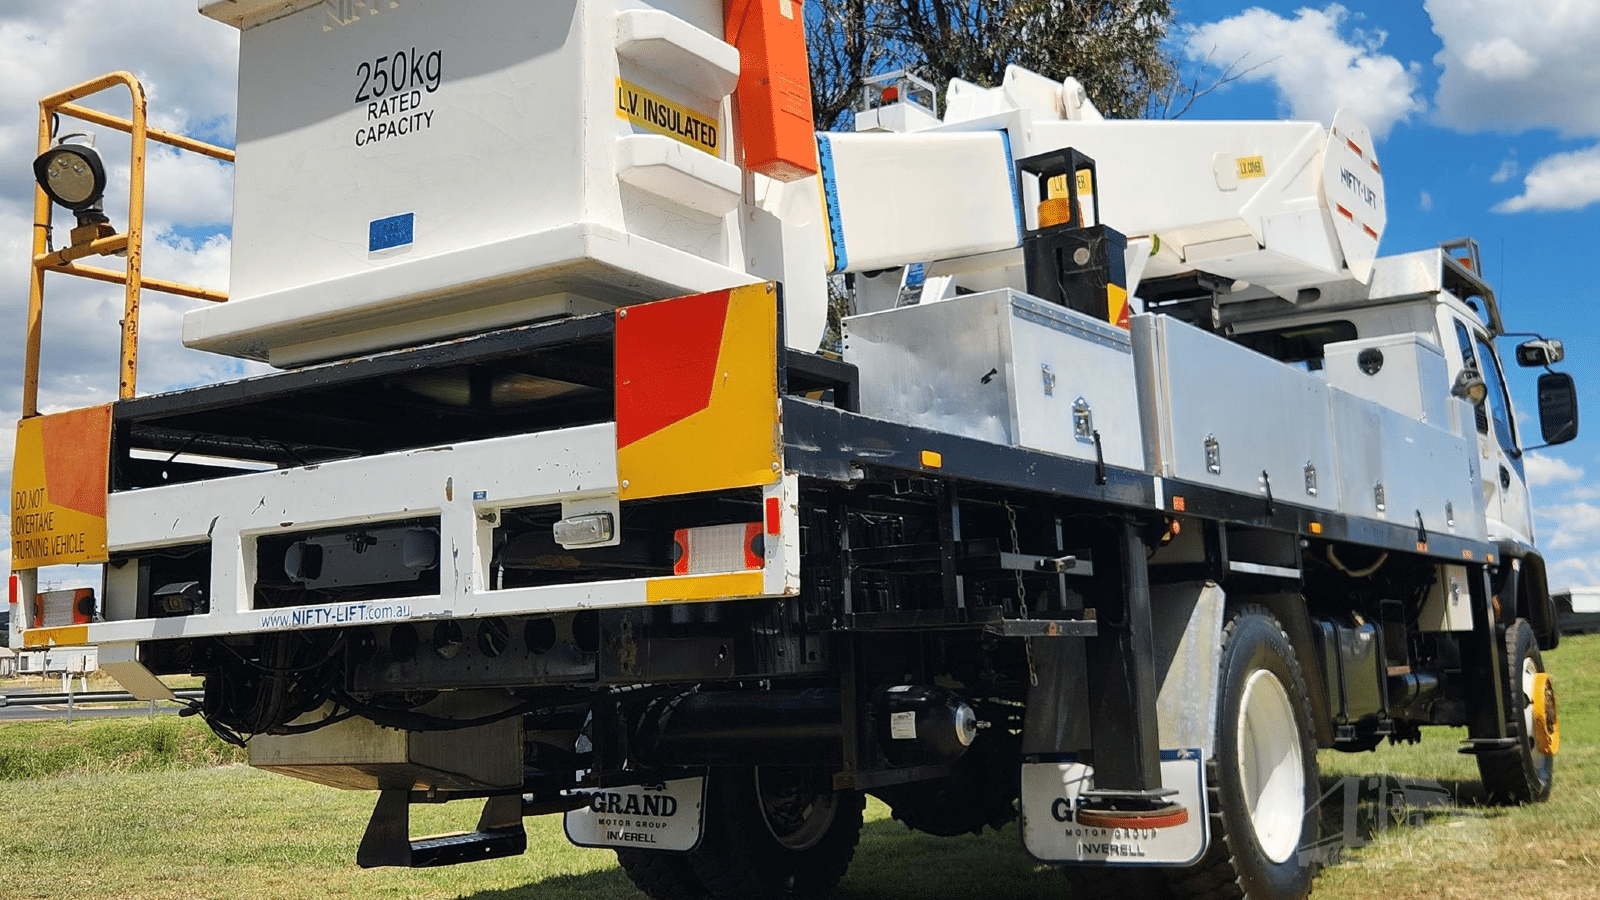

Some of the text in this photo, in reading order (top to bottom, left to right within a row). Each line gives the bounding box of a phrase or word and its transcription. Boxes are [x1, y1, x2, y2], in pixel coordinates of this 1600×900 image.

[355, 47, 441, 103] 250kg
[368, 90, 421, 121] RATED
[618, 86, 717, 148] L.V. INSULATED
[355, 110, 434, 146] CAPACITY
[16, 488, 45, 510] DO NOT
[16, 511, 54, 535] OVERTAKE
[16, 532, 85, 560] TURNING VEHICLE
[589, 791, 677, 817] GRAND
[598, 818, 667, 828] MOTOR GROUP
[1065, 828, 1107, 837] MOTOR
[607, 831, 656, 843] INVERELL
[1078, 843, 1145, 857] INVERELL
